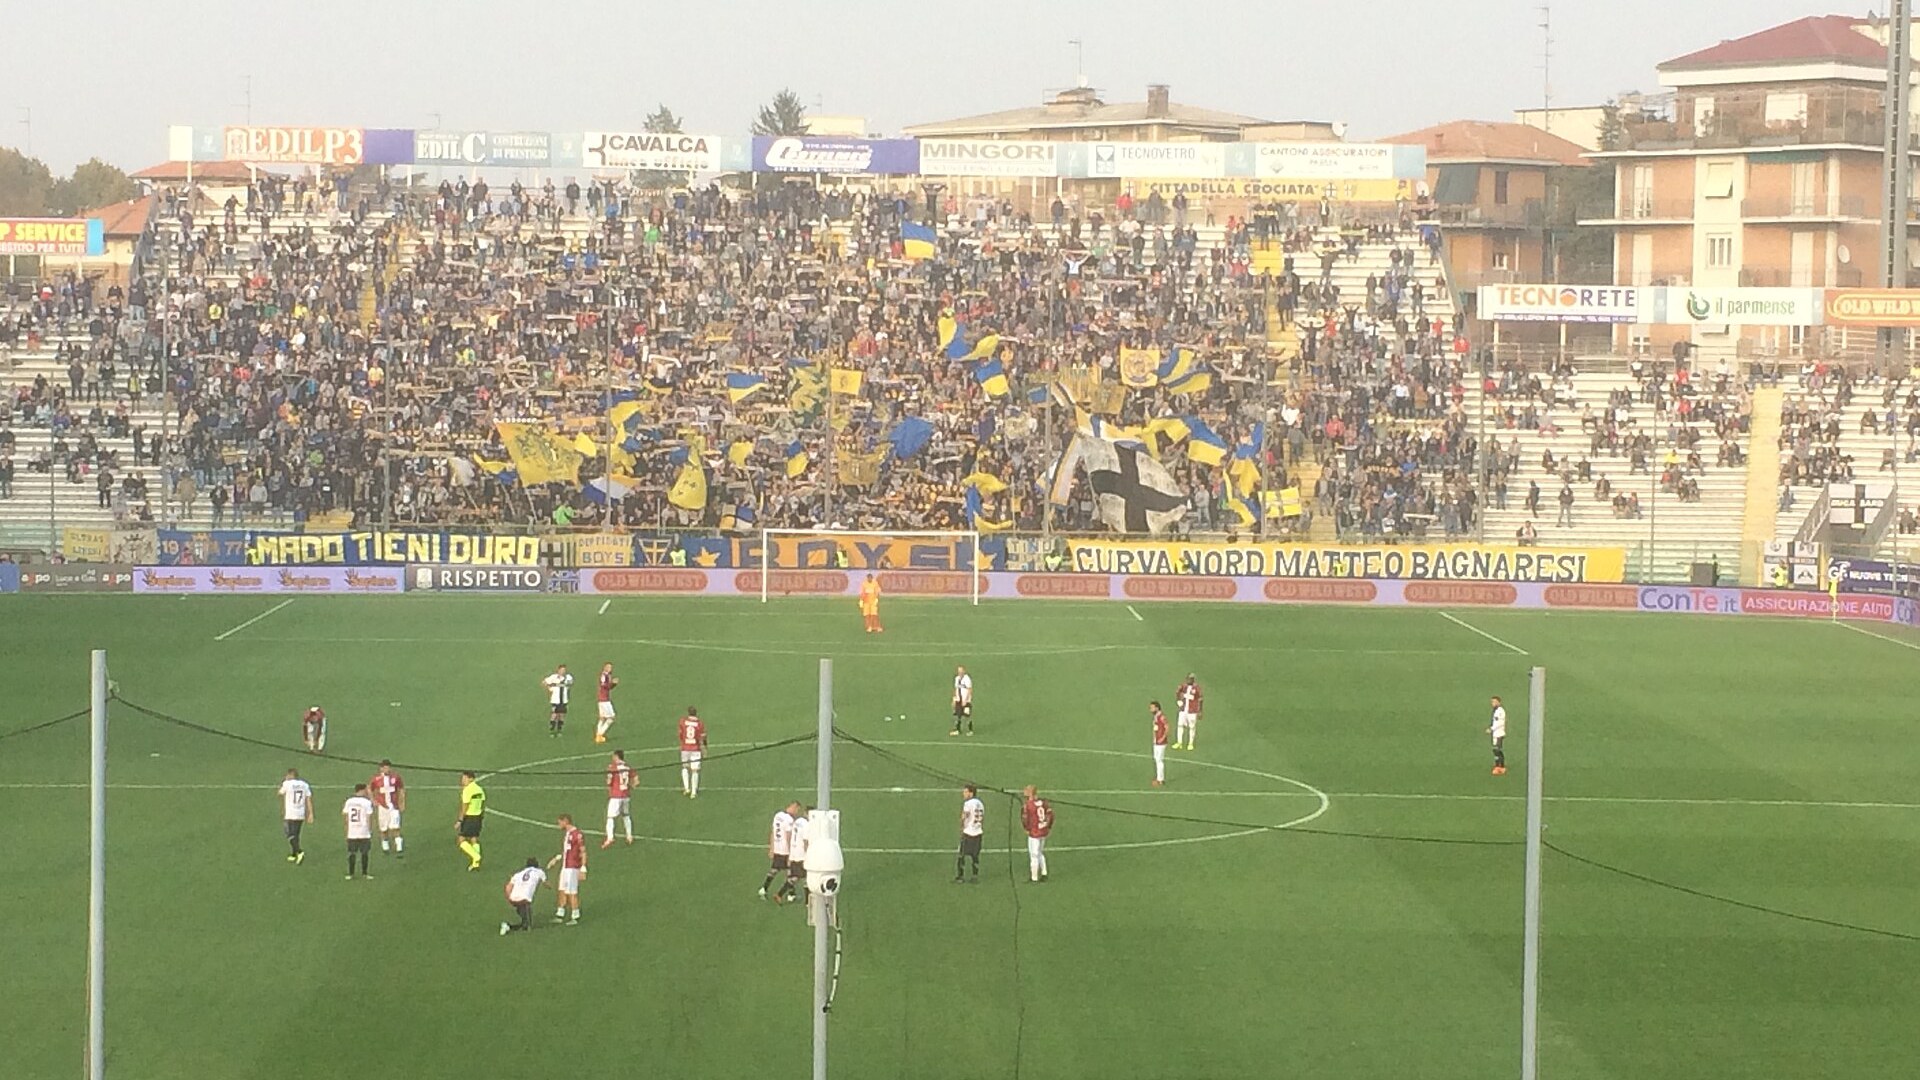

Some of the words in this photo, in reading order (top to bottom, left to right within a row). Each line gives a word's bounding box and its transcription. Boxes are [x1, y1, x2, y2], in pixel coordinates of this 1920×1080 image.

[608, 134, 709, 154] CAVALCA
[923, 143, 1054, 160] MINGORI
[1121, 147, 1196, 160] TECNOVETRO
[15, 223, 85, 242] SERVICE
[1727, 299, 1796, 317] parmense
[1841, 299, 1871, 315] OLD
[1872, 299, 1911, 315] WILD
[351, 531, 440, 563] TIENI
[449, 535, 540, 565] DURO
[582, 551, 624, 564] BOYS
[1075, 548, 1172, 575] CURVA
[1180, 550, 1264, 576] NORD
[1274, 550, 1404, 579] MATTEO
[1410, 551, 1586, 583] BAGNARESI
[440, 569, 541, 588] RISPETTO
[600, 574, 626, 587] OLD
[628, 574, 662, 588] WILD
[664, 575, 700, 589] WEST
[1640, 588, 1738, 613] ConTe.it
[1745, 596, 1859, 614] ASSICURAZIONE
[1861, 603, 1892, 617] AUTO
[293, 790, 303, 804] 17
[350, 808, 361, 823] 21
